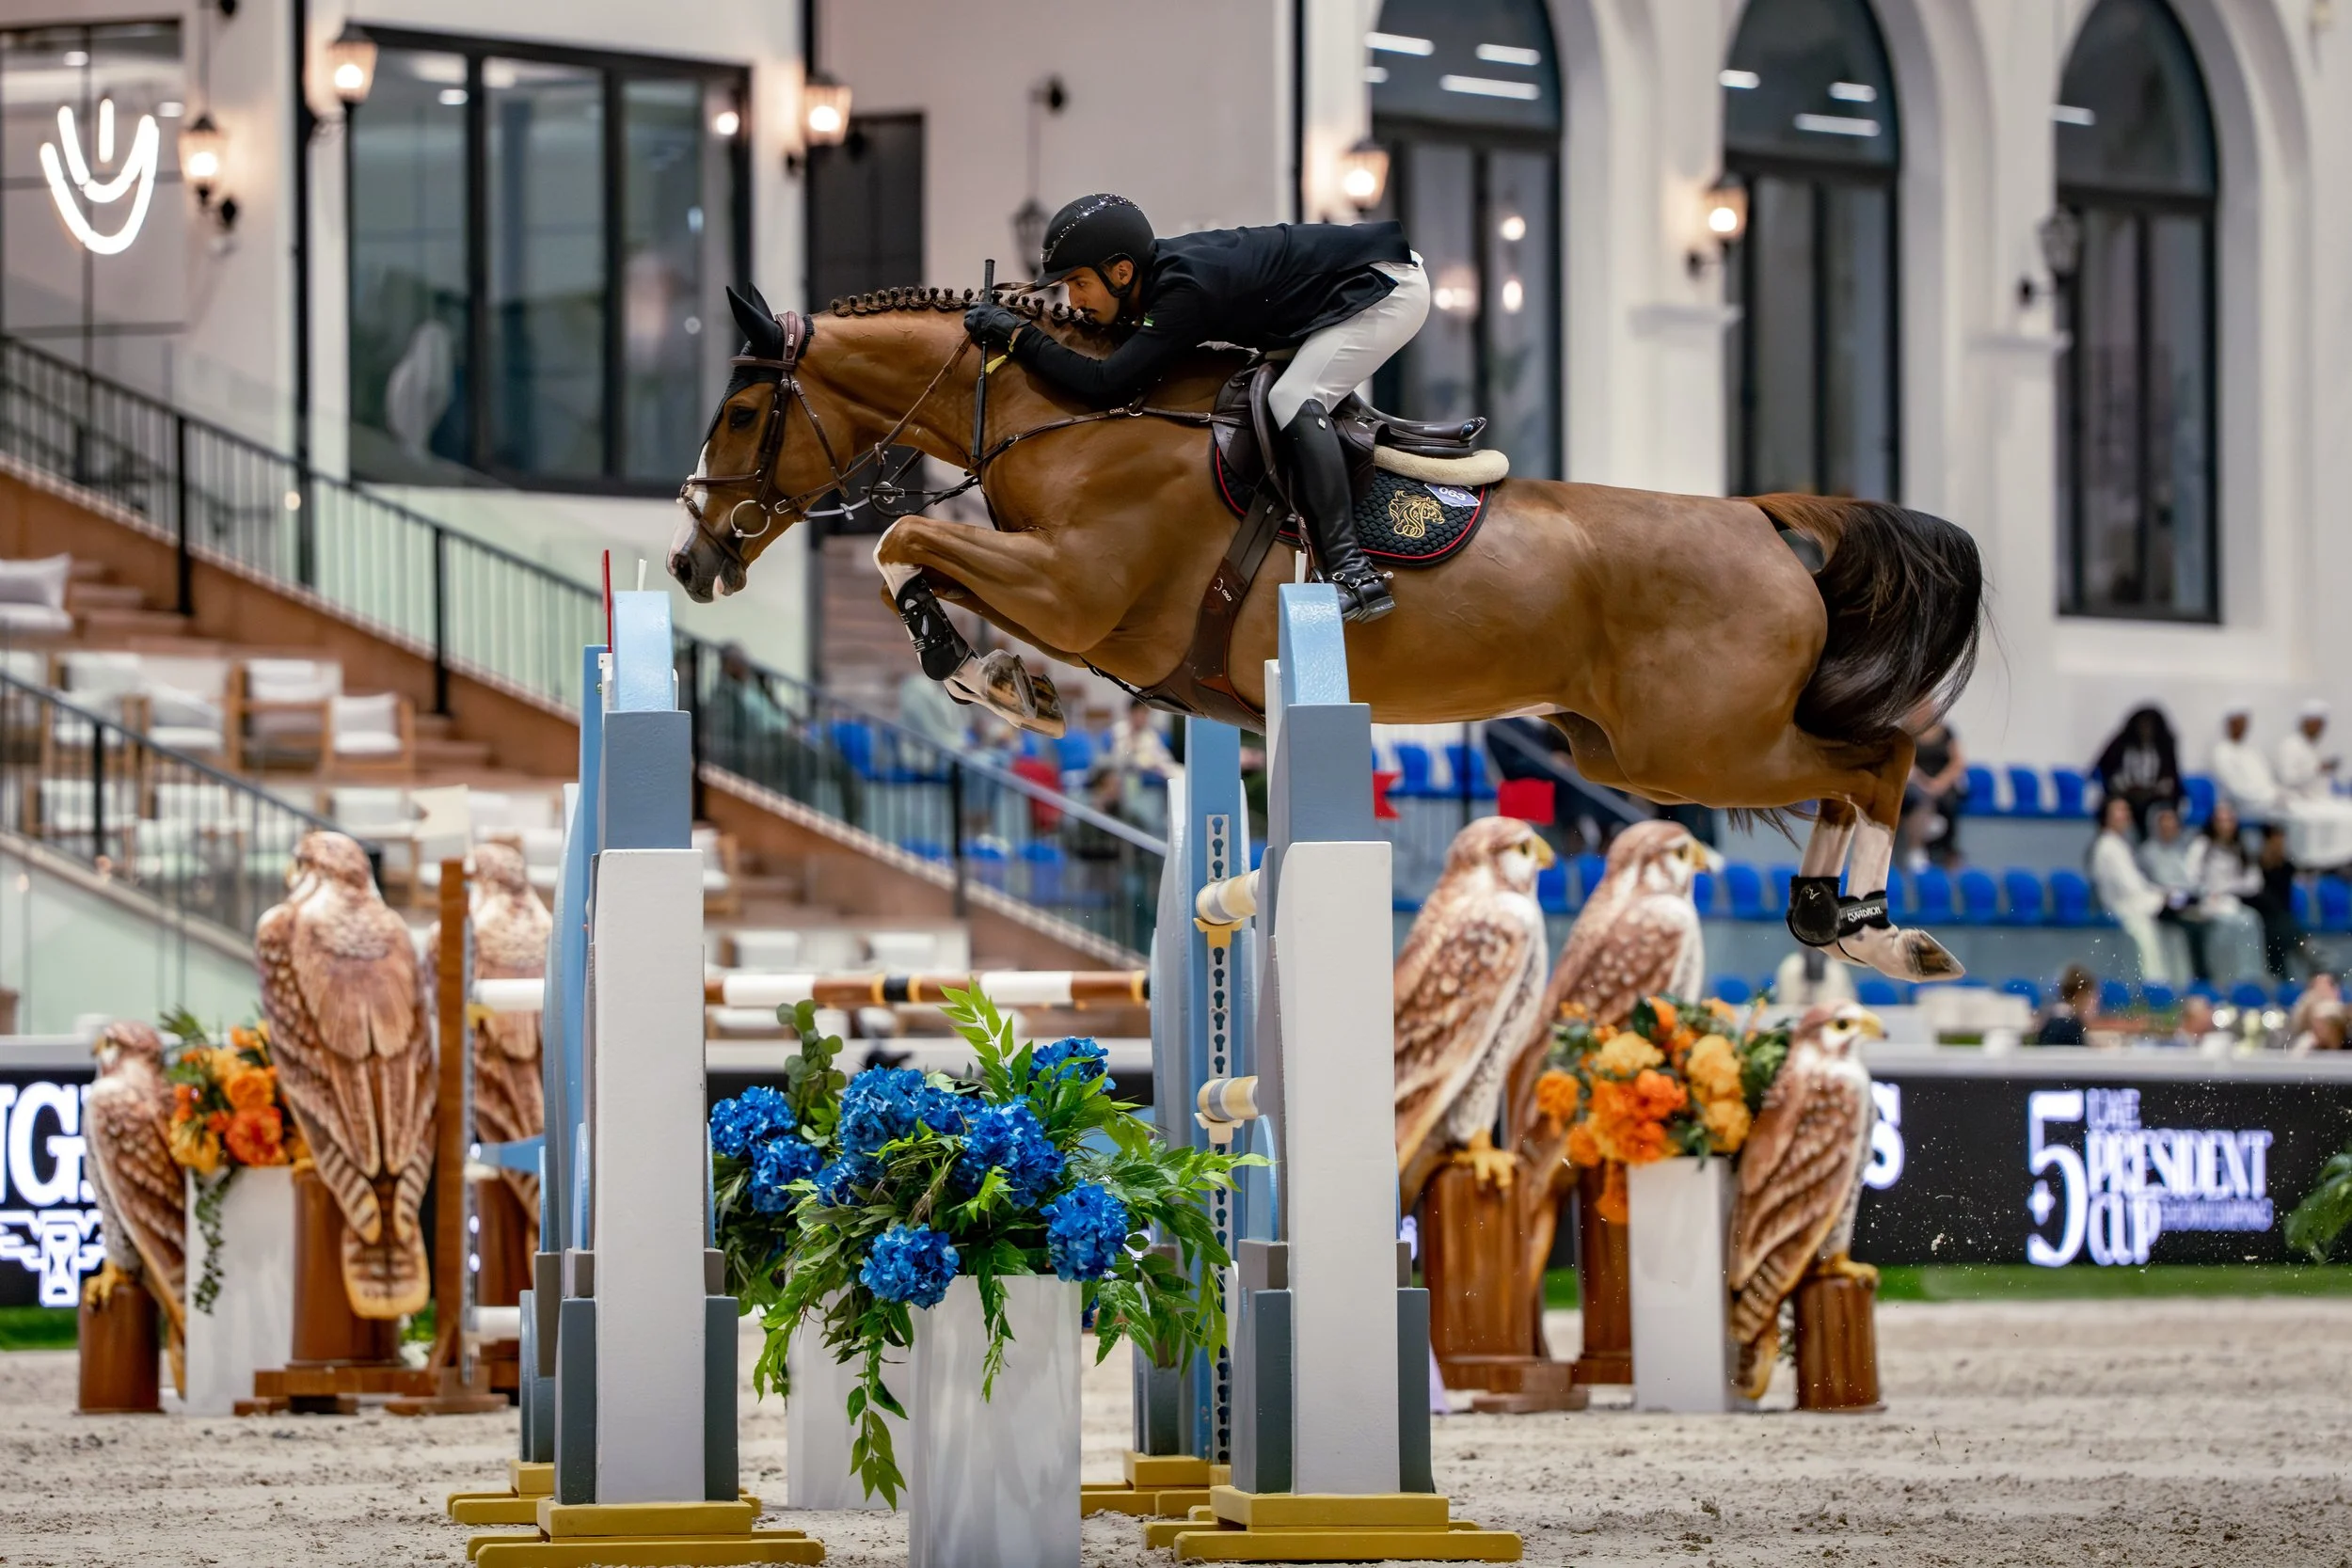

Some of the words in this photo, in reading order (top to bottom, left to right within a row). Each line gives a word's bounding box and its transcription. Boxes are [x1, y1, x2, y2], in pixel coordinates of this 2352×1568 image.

[1438, 486, 1467, 501] 063
[2027, 1090, 2088, 1267] 5
[2085, 1128, 2273, 1201] PRESIDENT
[2087, 1192, 2162, 1266] CUP
